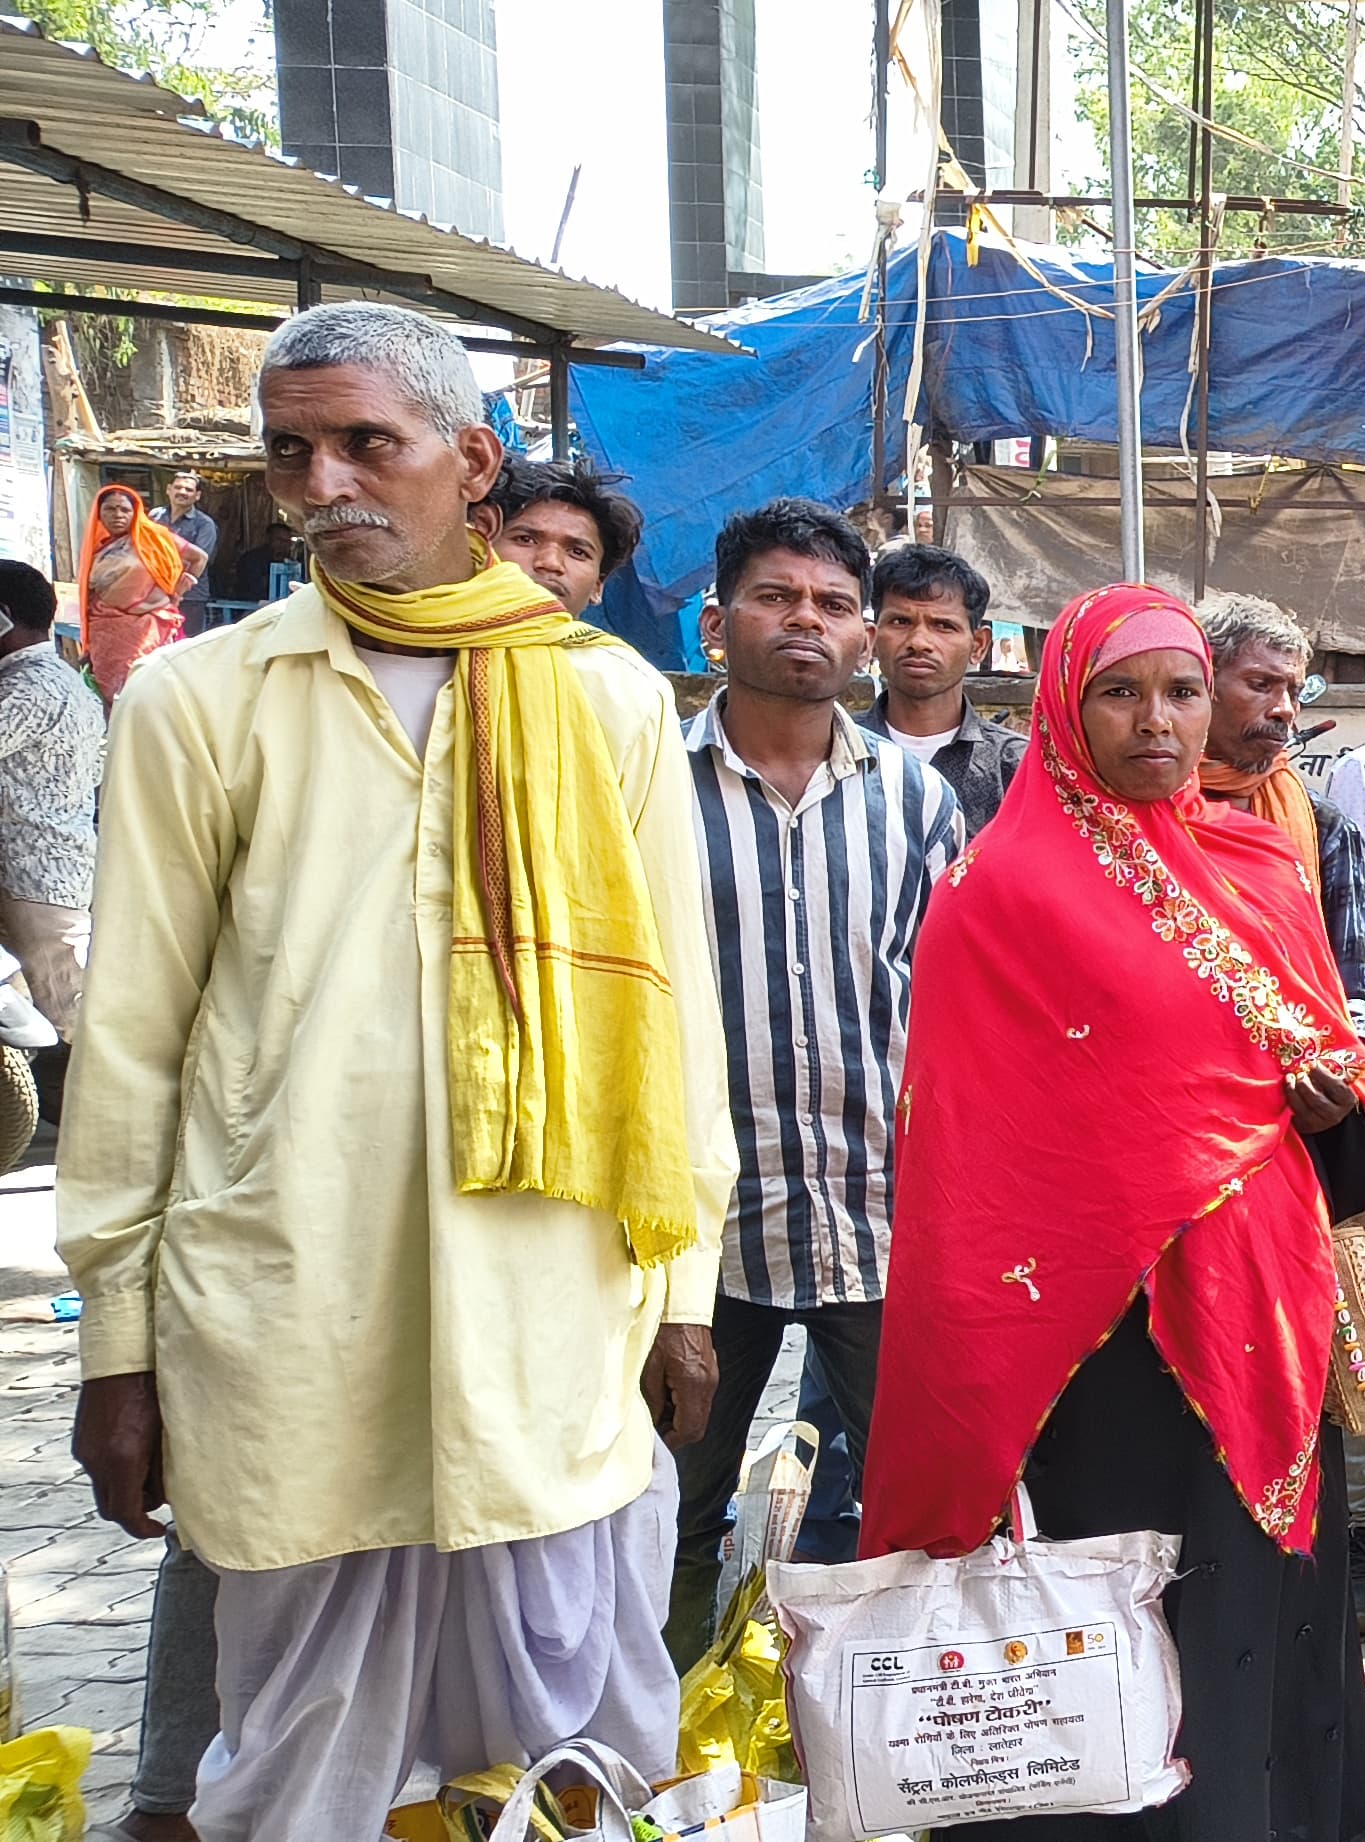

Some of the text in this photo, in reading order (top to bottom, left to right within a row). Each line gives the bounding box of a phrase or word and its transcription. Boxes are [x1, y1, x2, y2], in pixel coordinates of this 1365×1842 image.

[870, 1655, 904, 1671] CCL
[918, 1699, 1051, 1727] “पोषण टोकरी”
[897, 1758, 1081, 1796] सेंट्रल कोलफील्ड्स लिमिटेड
